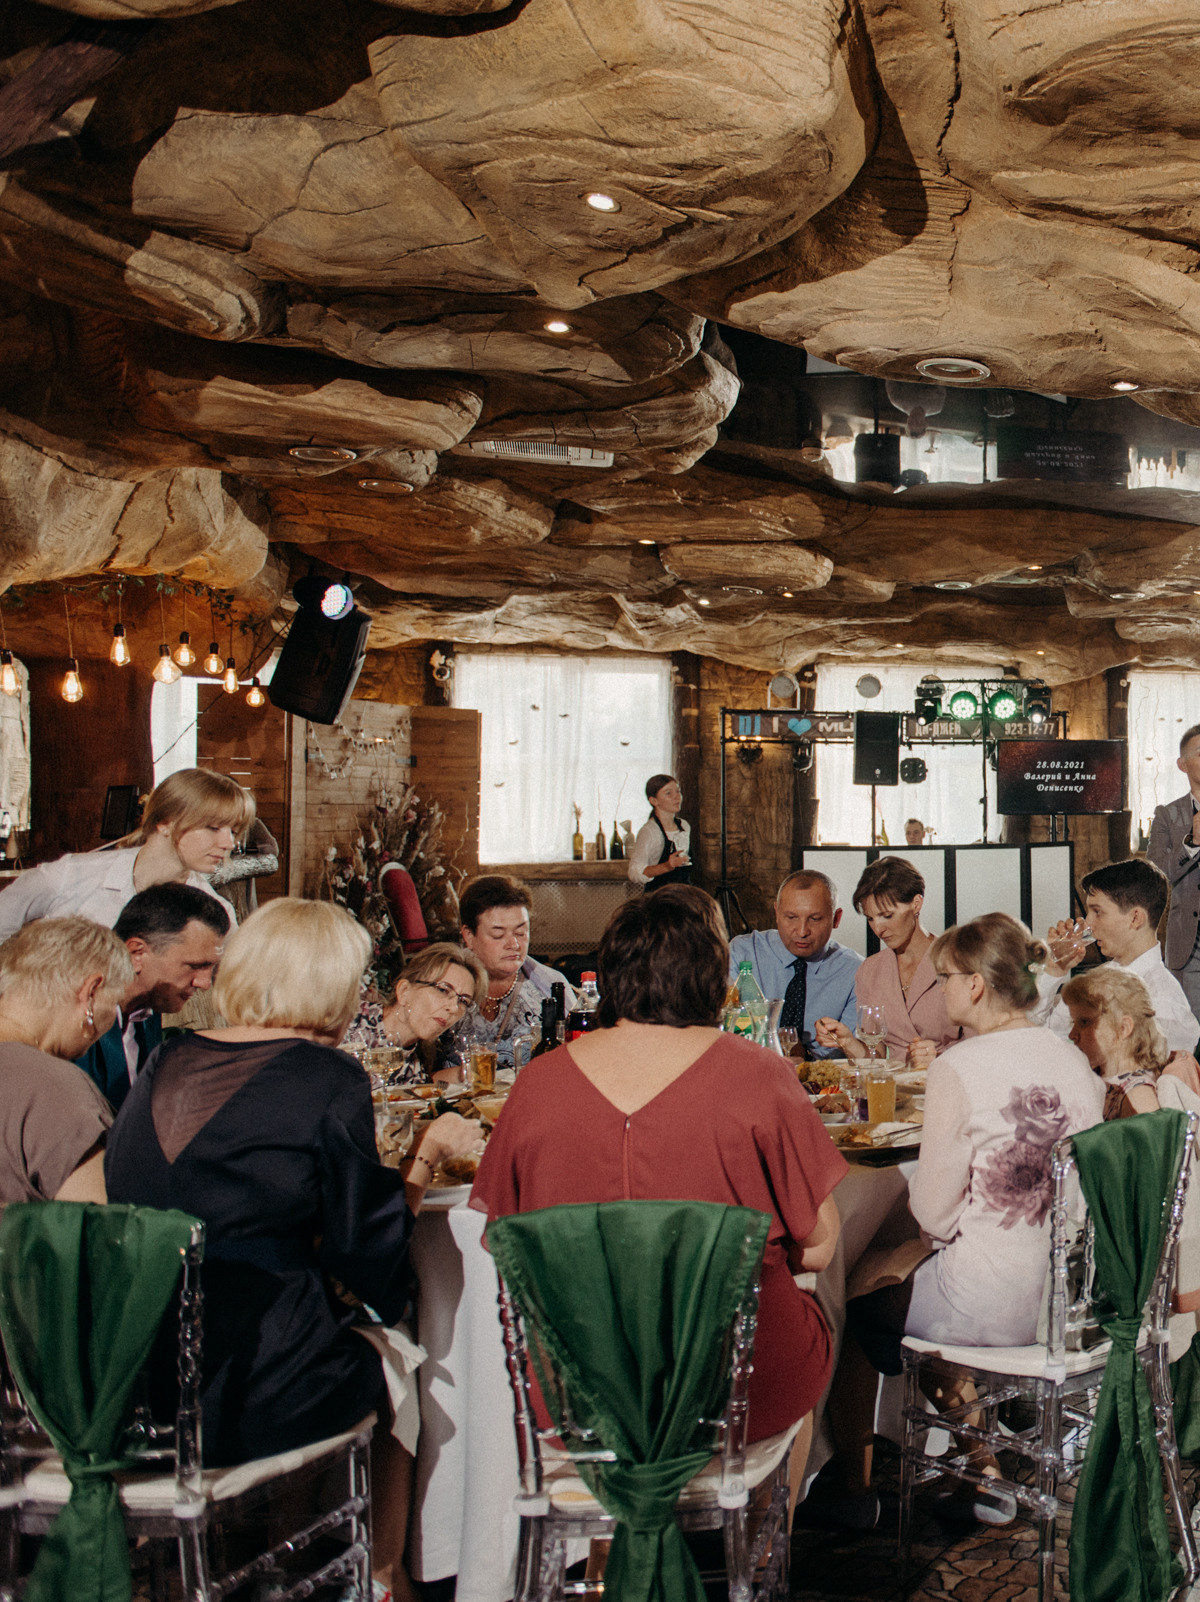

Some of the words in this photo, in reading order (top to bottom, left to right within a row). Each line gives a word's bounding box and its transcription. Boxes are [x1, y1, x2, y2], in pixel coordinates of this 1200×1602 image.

[739, 715, 761, 736] DJ
[773, 717, 779, 733] I
[819, 722, 855, 733] MU
[1004, 722, 1055, 735] 923-12-77
[1036, 761, 1085, 769] 28.08.2021
[1024, 772, 1062, 782] Валерий
[1072, 772, 1097, 780] Анна
[1036, 784, 1084, 793] Денисенко
